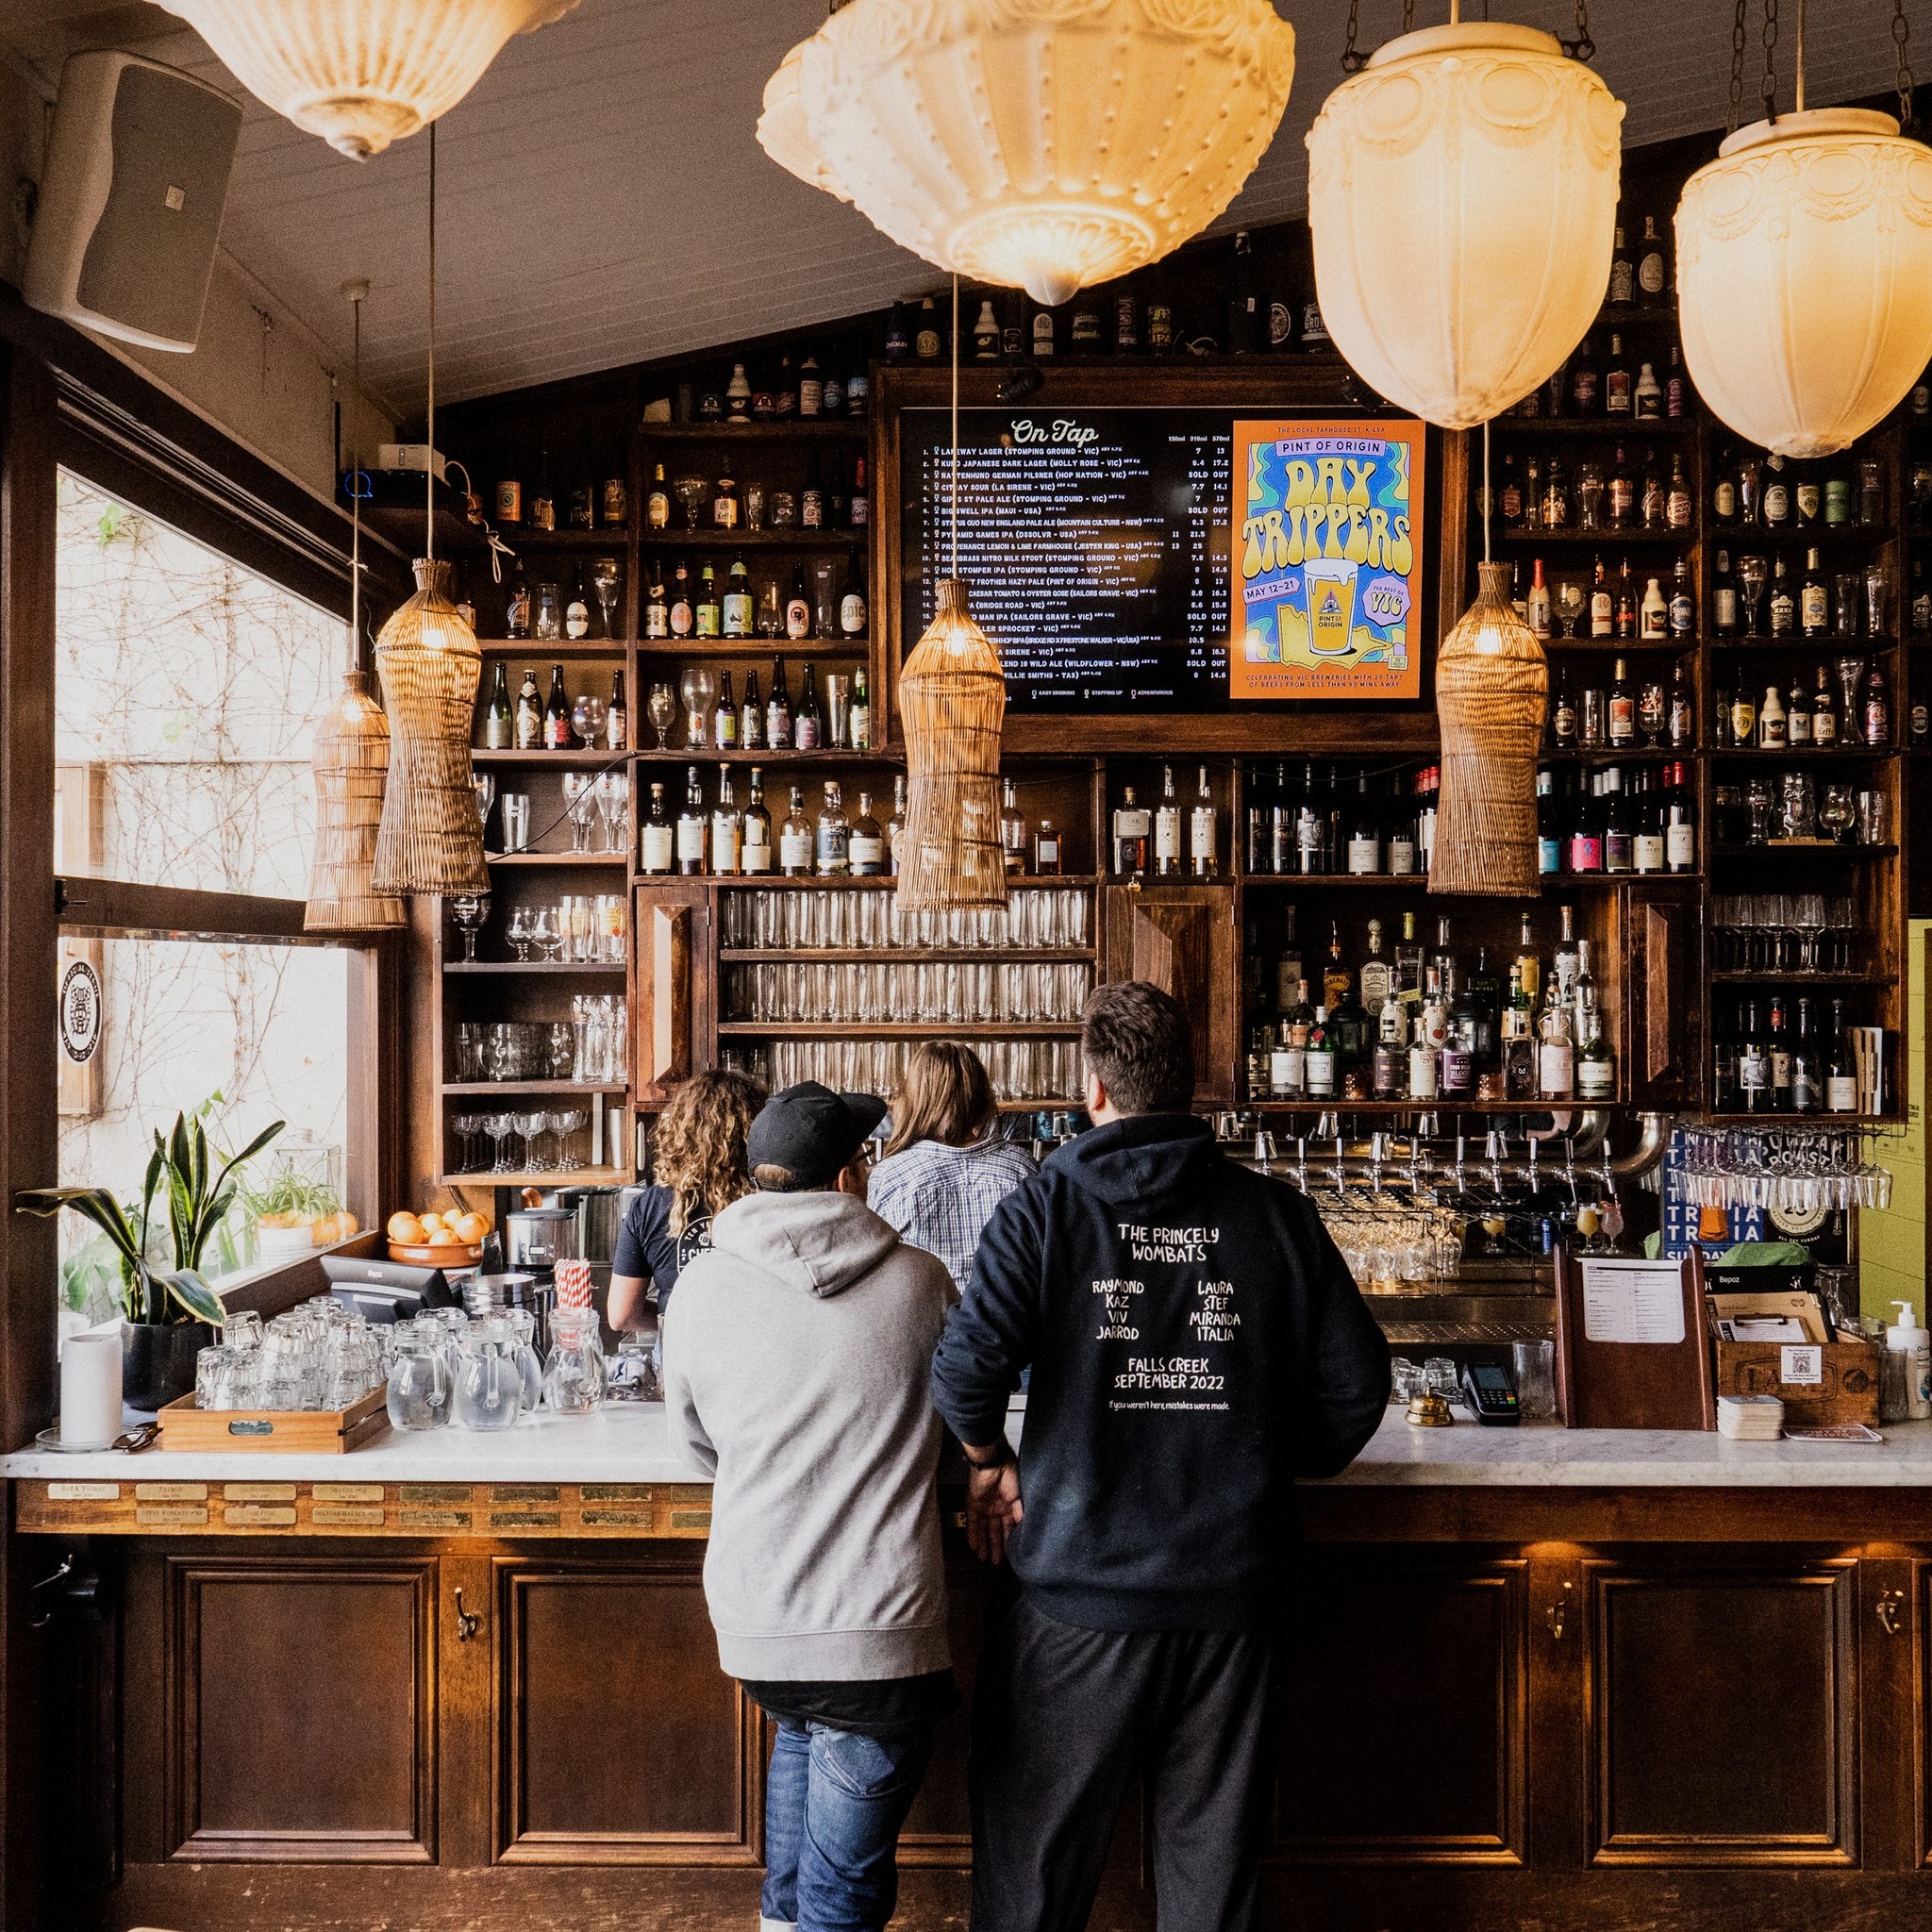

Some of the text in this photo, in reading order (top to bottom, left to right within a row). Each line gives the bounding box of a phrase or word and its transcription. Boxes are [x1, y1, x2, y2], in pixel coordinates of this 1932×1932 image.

[1011, 419, 1099, 449] On Tap
[1005, 447, 1044, 456] (STOMPING
[1084, 447, 1100, 456] VIC)
[1283, 441, 1381, 453] PINT OF ORIGIN
[1050, 458, 1077, 468] (MOLLY
[1107, 458, 1122, 468] VIC)
[1056, 471, 1074, 479] (HOP
[1111, 471, 1126, 479] VIC)
[991, 483, 1005, 491] (LA
[1040, 483, 1056, 491] VIC)
[1285, 457, 1376, 509] DAY
[996, 507, 1016, 515] (MAUI
[1024, 507, 1041, 515] USA)
[1060, 530, 1077, 539] USA)
[1241, 503, 1413, 579] TRIPPERS
[1246, 580, 1294, 599] MAY 12-21
[1371, 591, 1403, 616] VIC
[1043, 625, 1059, 633] VIC)
[1667, 1206, 1759, 1223] TRIA
[684, 1226, 699, 1241] TEN
[1118, 1224, 1220, 1244] THE PRINCELY
[1667, 1225, 1759, 1241] TRIA
[1778, 1234, 1788, 1242] ALL
[1132, 1243, 1207, 1262] WOMBATS
[1092, 1278, 1144, 1294] RAYMOND
[1719, 1275, 1740, 1284] Bepoz
[1197, 1280, 1234, 1295] LAURA
[1106, 1293, 1129, 1308] KAZ
[1203, 1295, 1228, 1310] STEF
[1108, 1310, 1127, 1324] VIV
[1190, 1311, 1241, 1326] MIRANDA
[1096, 1325, 1140, 1341] JARROD
[1197, 1326, 1234, 1341] ITALIA
[1128, 1357, 1209, 1374] FALLS CREEK
[1114, 1373, 1224, 1390] SEPTEMBER 2022
[1113, 1401, 1126, 1411] you
[1126, 1401, 1150, 1409] weren't
[1165, 1401, 1192, 1410] mistakes
